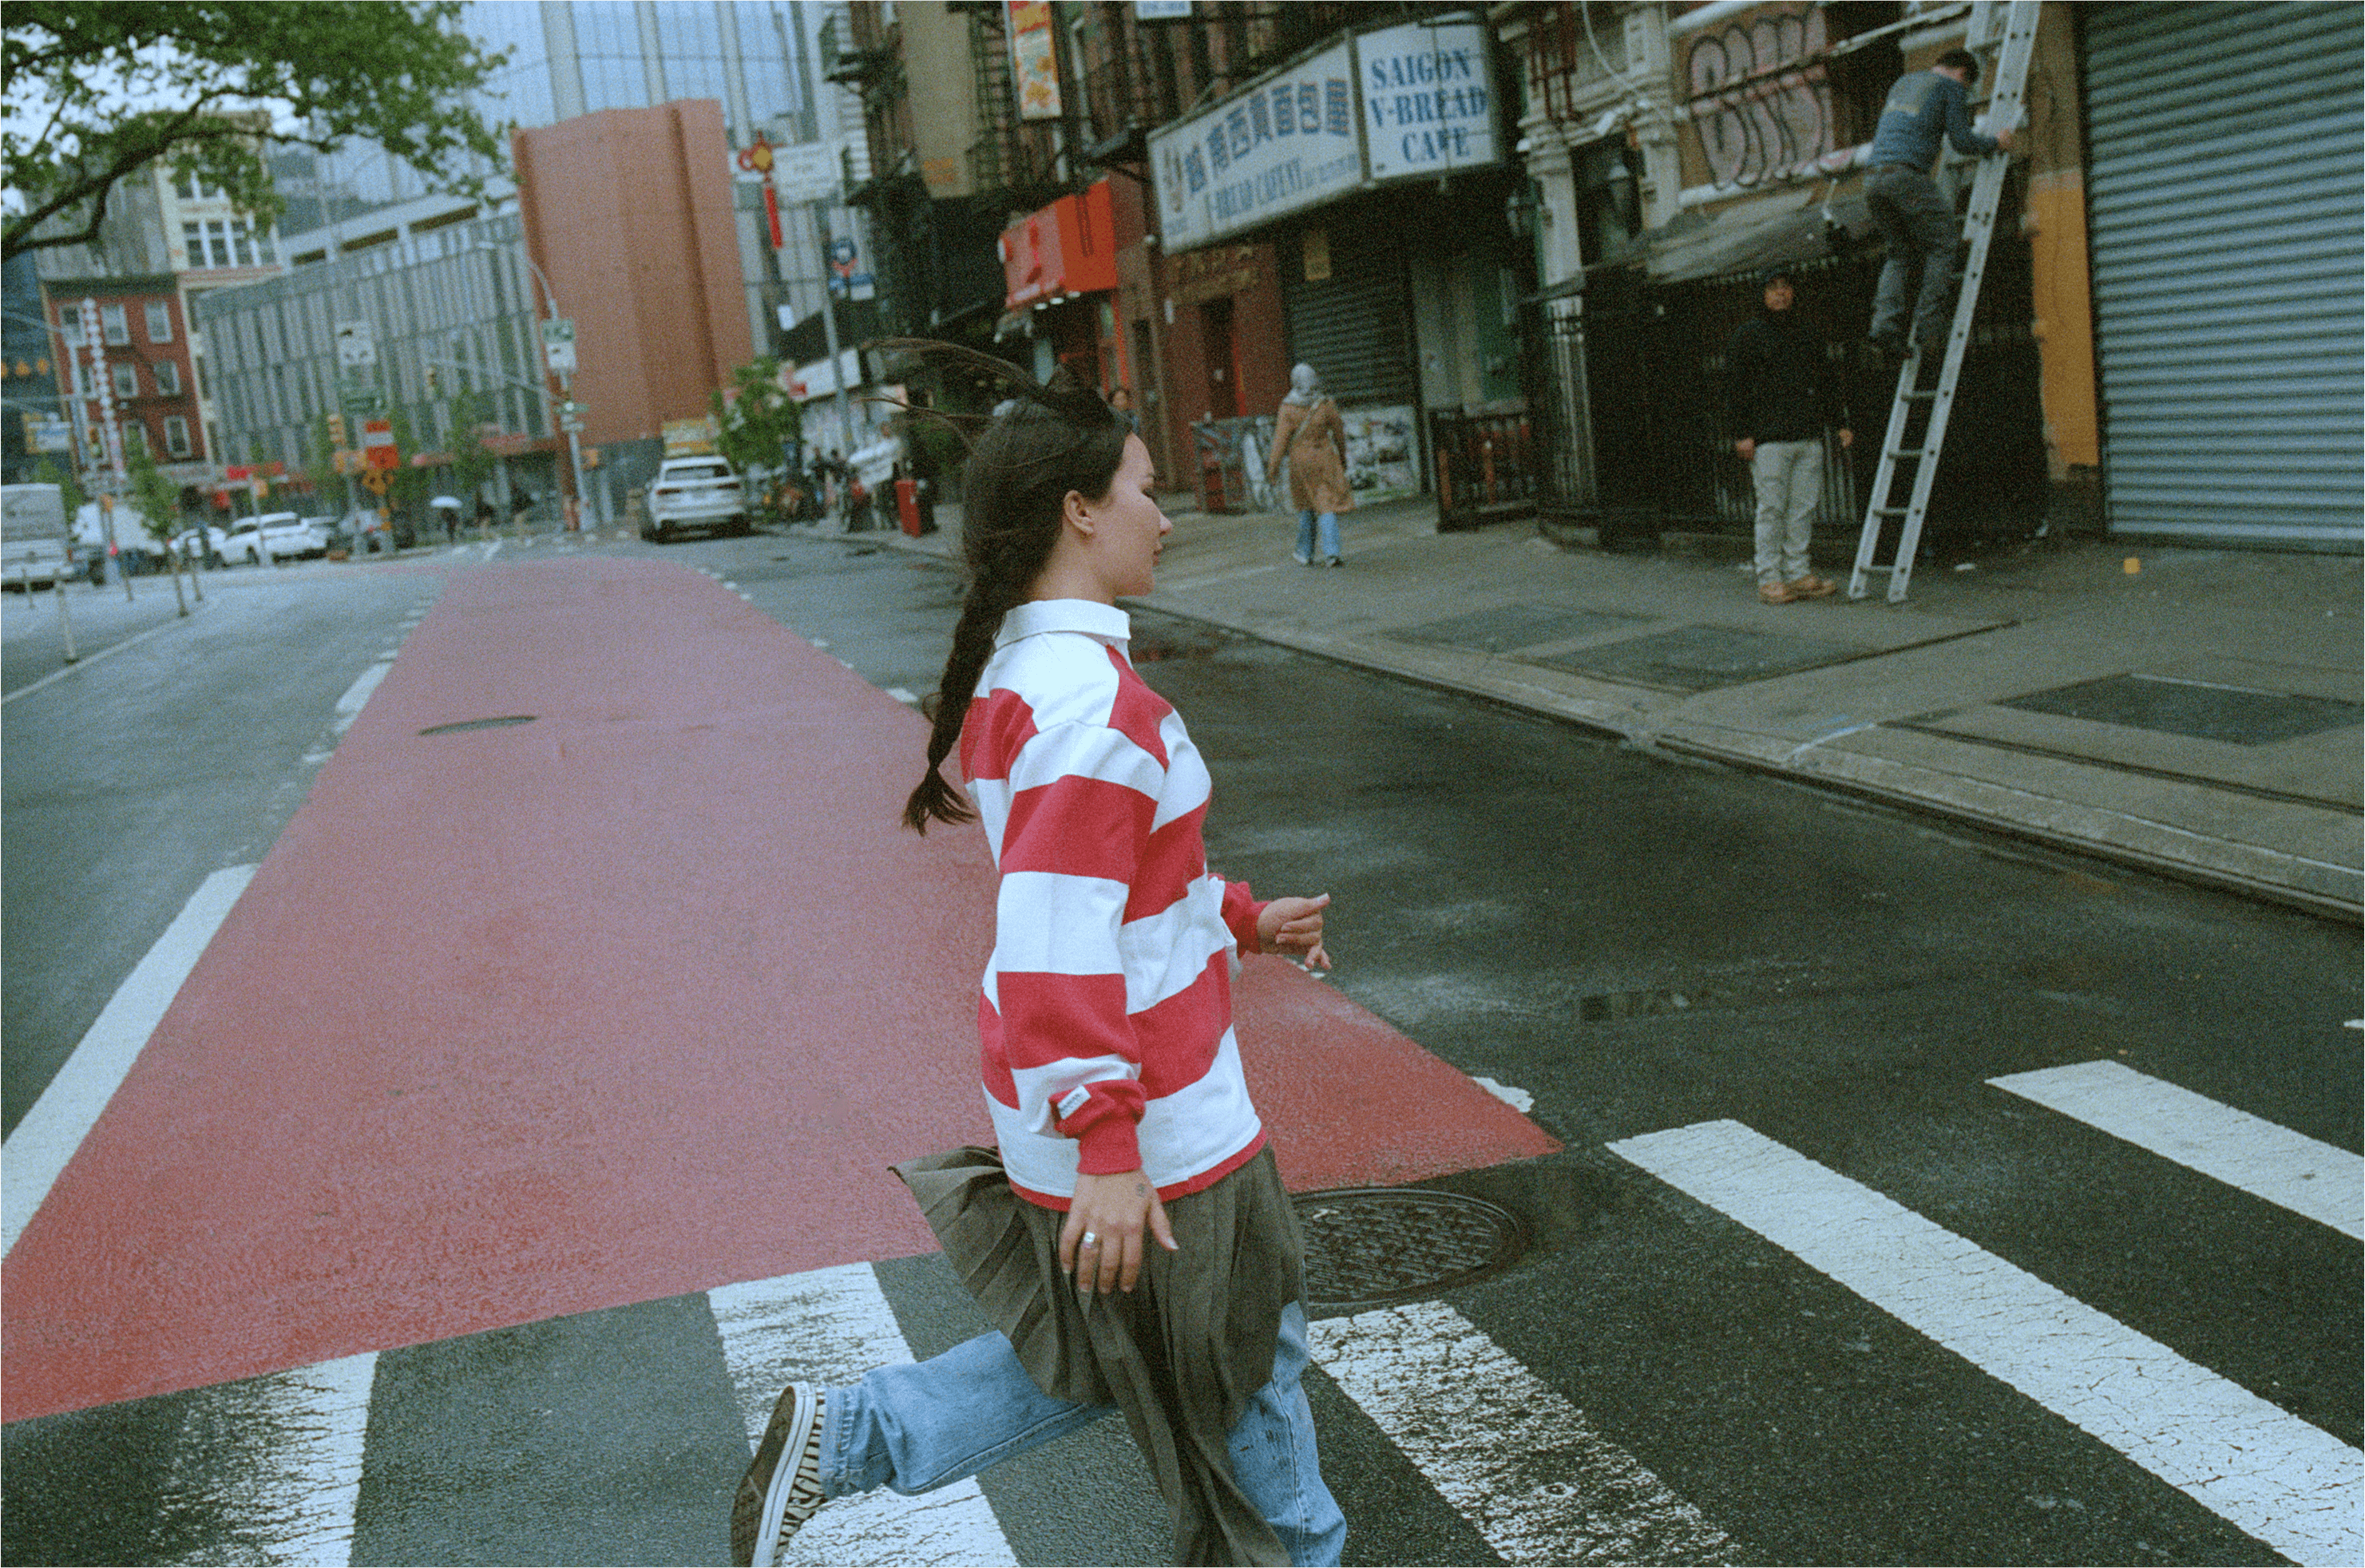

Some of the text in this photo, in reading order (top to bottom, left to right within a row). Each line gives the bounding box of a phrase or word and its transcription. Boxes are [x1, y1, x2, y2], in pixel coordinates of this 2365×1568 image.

[1370, 48, 1471, 89] SAIGON
[1369, 86, 1488, 128] V-BREAD
[1401, 126, 1471, 164] CAFE
